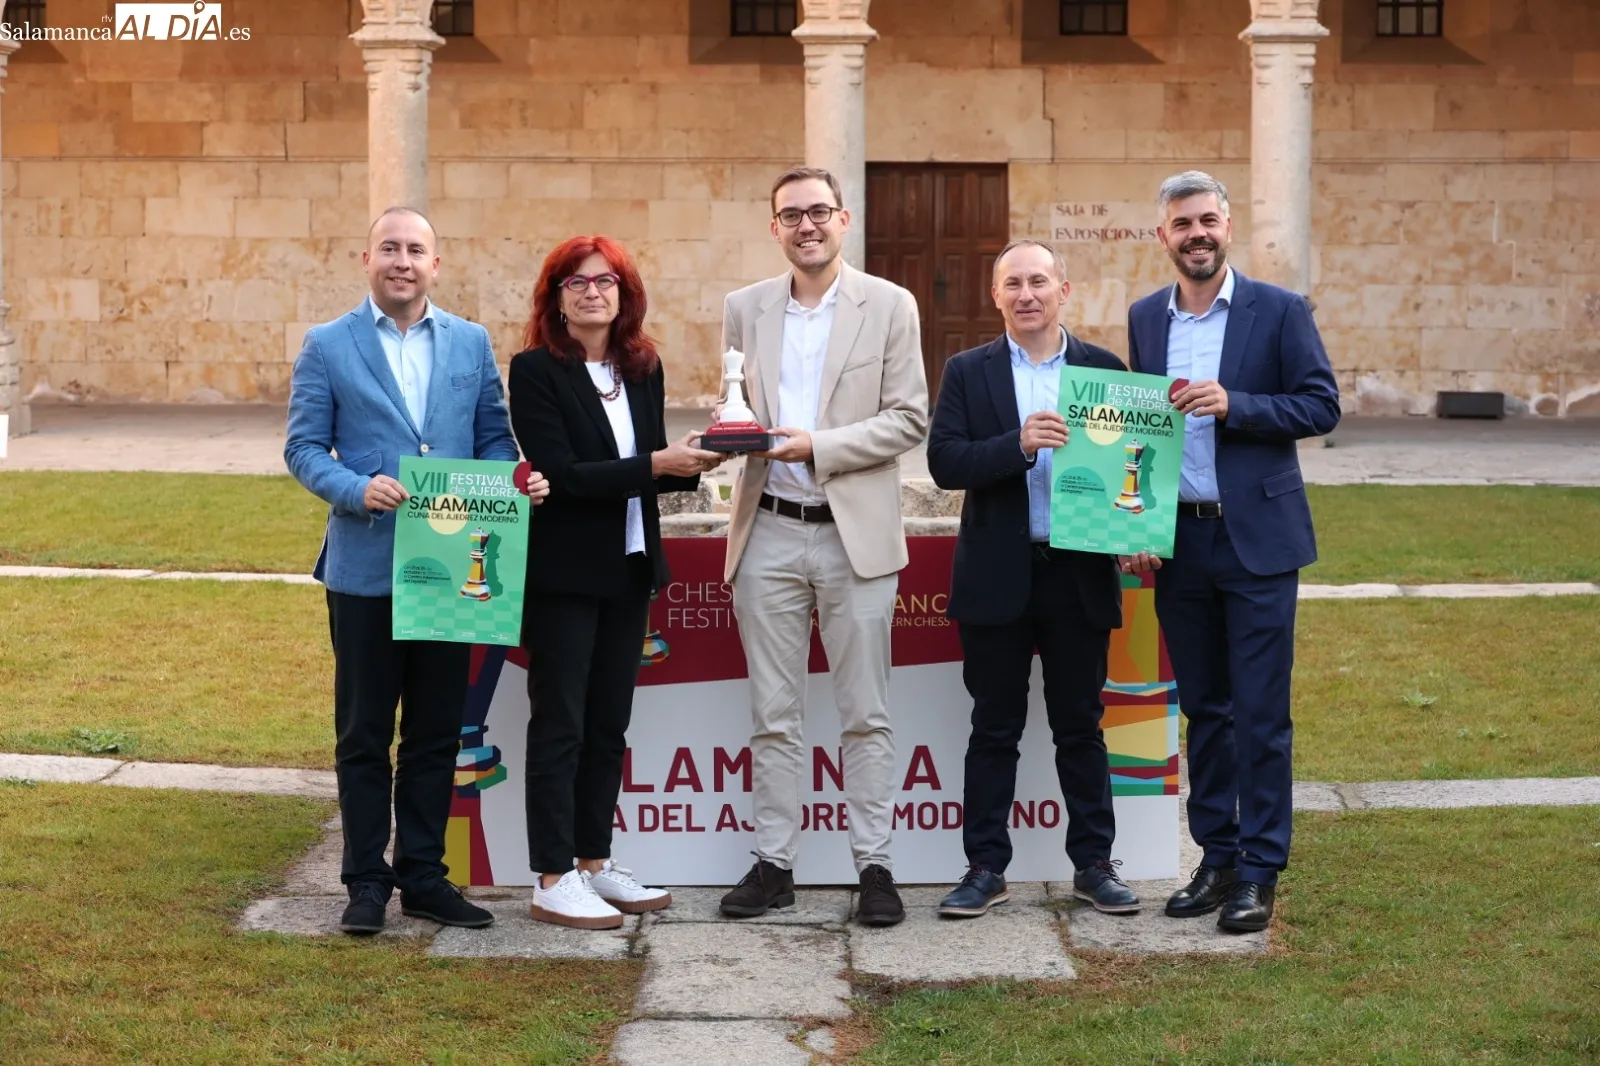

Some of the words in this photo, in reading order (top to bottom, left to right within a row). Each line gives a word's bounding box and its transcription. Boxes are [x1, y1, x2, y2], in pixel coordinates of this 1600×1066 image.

[1091, 203, 1109, 217] DE
[1055, 227, 1157, 240] EXPOSICIONES
[1070, 379, 1106, 404] VIII
[1107, 383, 1166, 402] FESTIVAL
[1106, 397, 1123, 407] de
[1125, 397, 1175, 413] AJEDREZ
[1068, 404, 1174, 429] SALAMANCA
[1066, 420, 1088, 429] CUNA
[1088, 422, 1102, 431] DEL
[1102, 422, 1134, 434] AJEDREZ
[1135, 427, 1174, 438] MODERNO
[410, 470, 448, 493] VIII
[449, 472, 511, 488] FESTIVAL
[449, 484, 466, 496] de
[468, 486, 520, 498] AJEDREZ
[409, 495, 518, 516] SALAMANCA
[407, 511, 430, 519] CUNA
[431, 511, 445, 520] DEL
[445, 512, 478, 522] AJEDREZ
[479, 514, 519, 524] MODERNO
[667, 582, 733, 603] CHES
[668, 607, 736, 629] FESTI
[914, 616, 951, 627] CHESS
[638, 803, 706, 832] DEL
